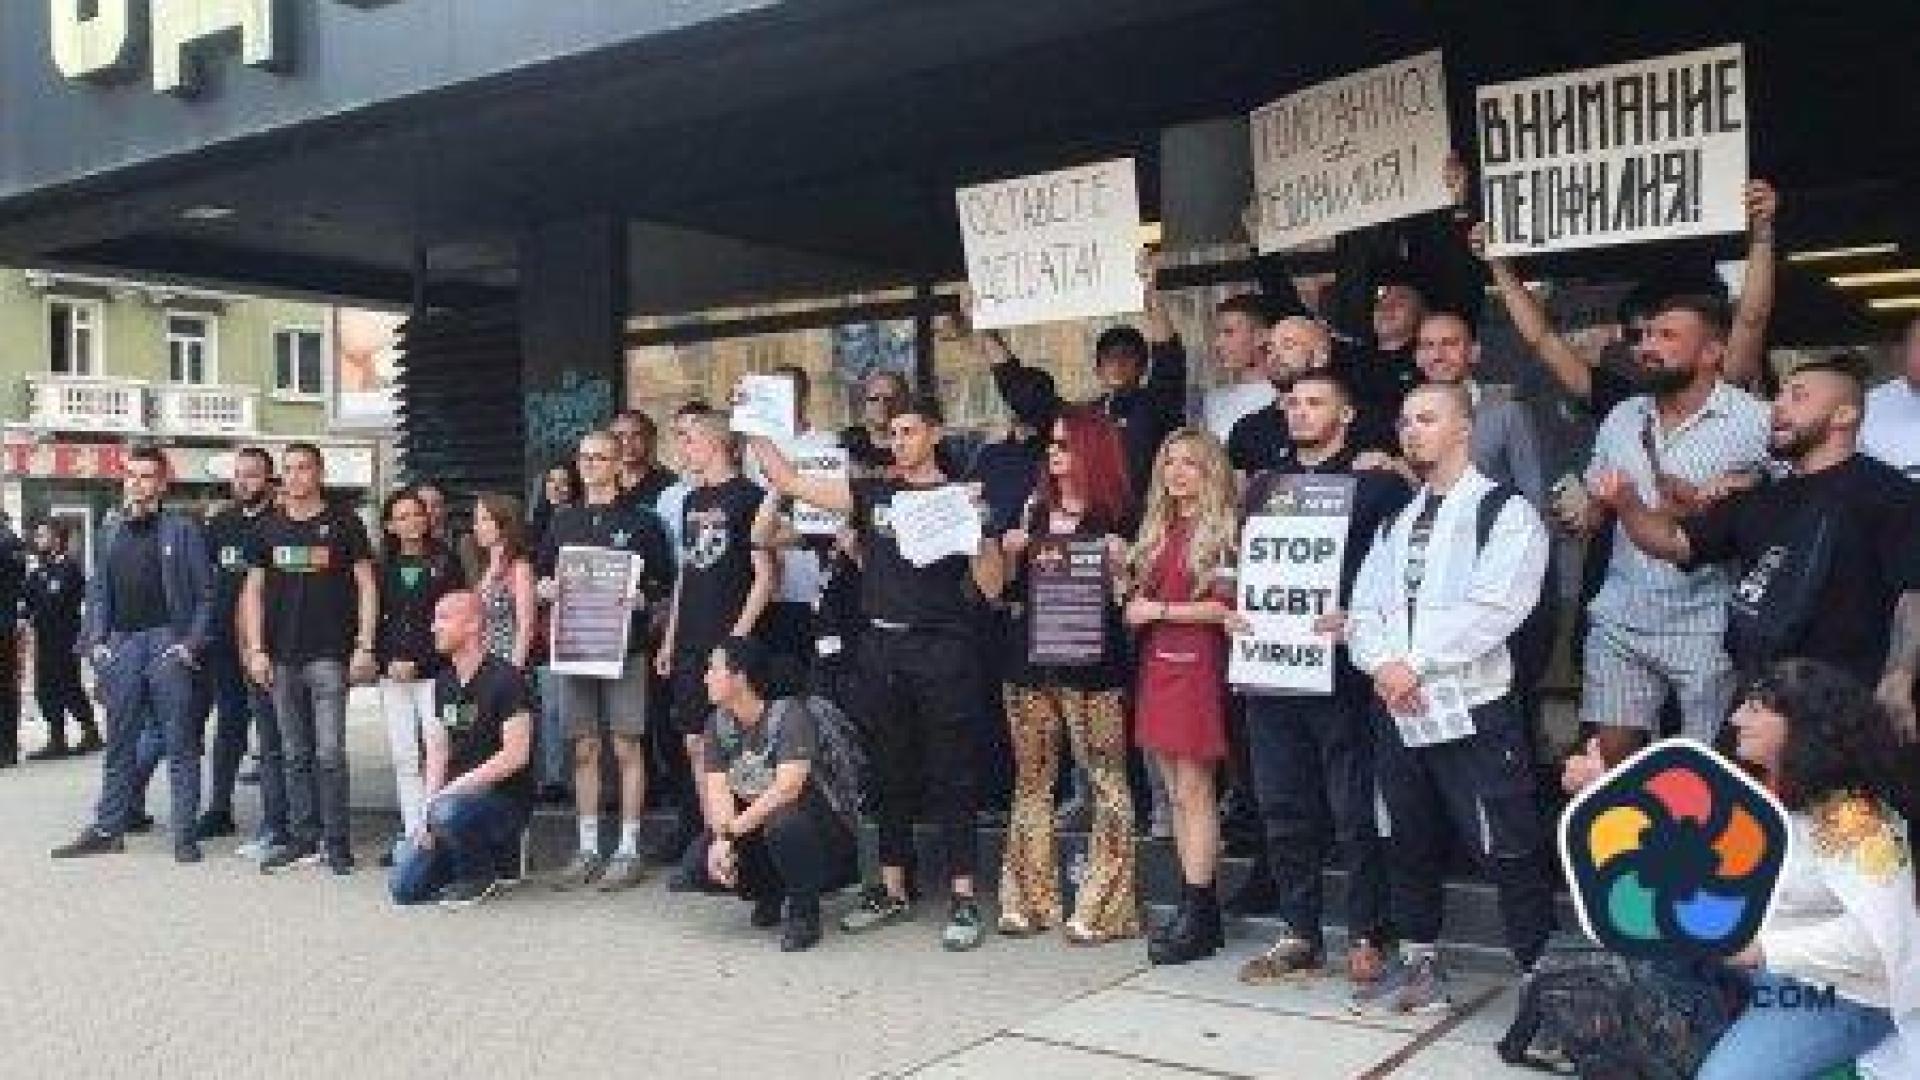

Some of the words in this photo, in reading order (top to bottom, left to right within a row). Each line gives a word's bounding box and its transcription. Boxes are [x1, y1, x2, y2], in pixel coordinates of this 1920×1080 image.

[1480, 60, 1742, 163] ВНИМАНИЕ
[1484, 150, 1702, 248] ПЕДОФИЛИЯ!
[1249, 537, 1336, 564] STOP
[1245, 585, 1332, 615] LGBT
